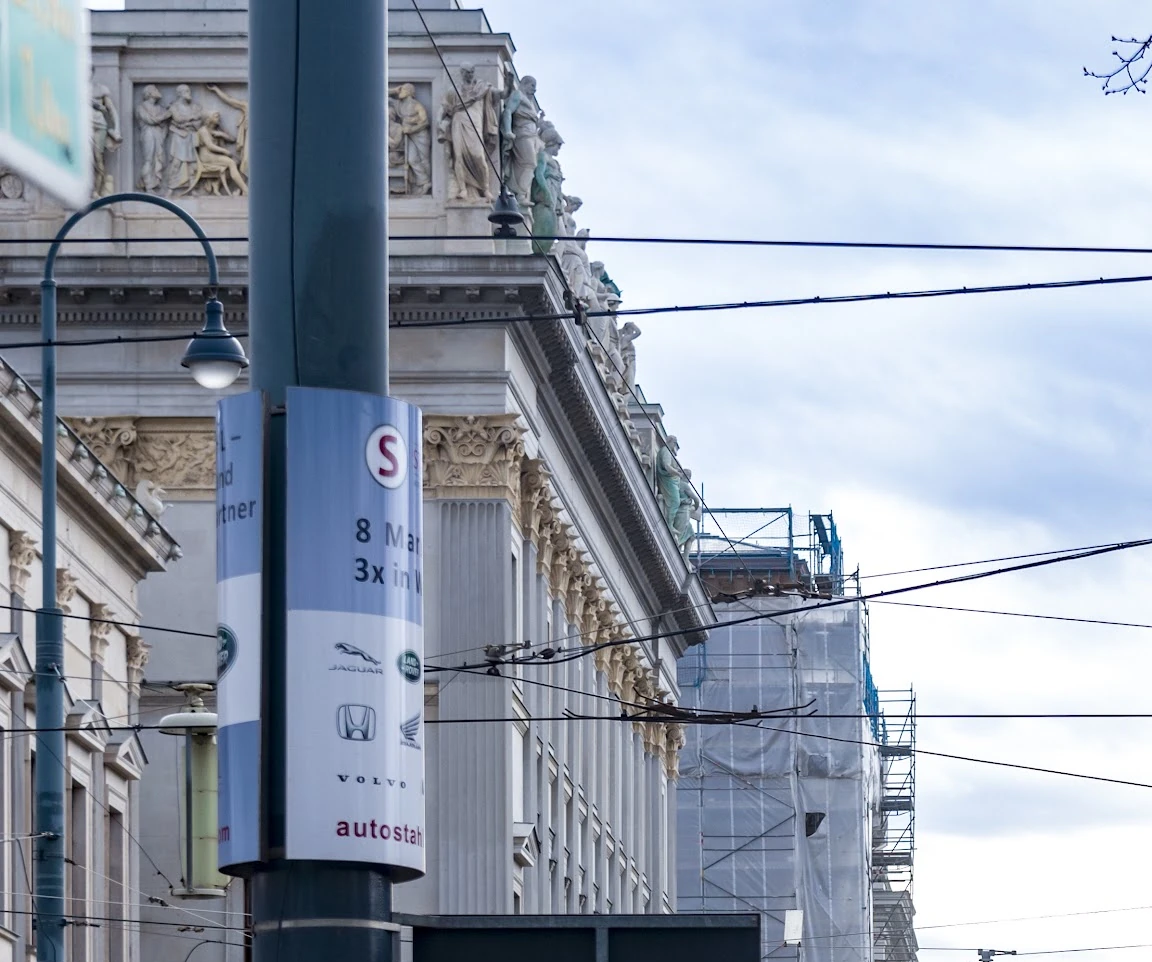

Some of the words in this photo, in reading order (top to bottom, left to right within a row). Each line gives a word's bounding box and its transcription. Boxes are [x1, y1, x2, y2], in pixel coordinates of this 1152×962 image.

[355, 518, 372, 544] 8
[385, 521, 420, 554] Mar
[354, 557, 385, 585] 3x
[328, 663, 384, 676] JAGUAR
[336, 774, 407, 789] VOLVO
